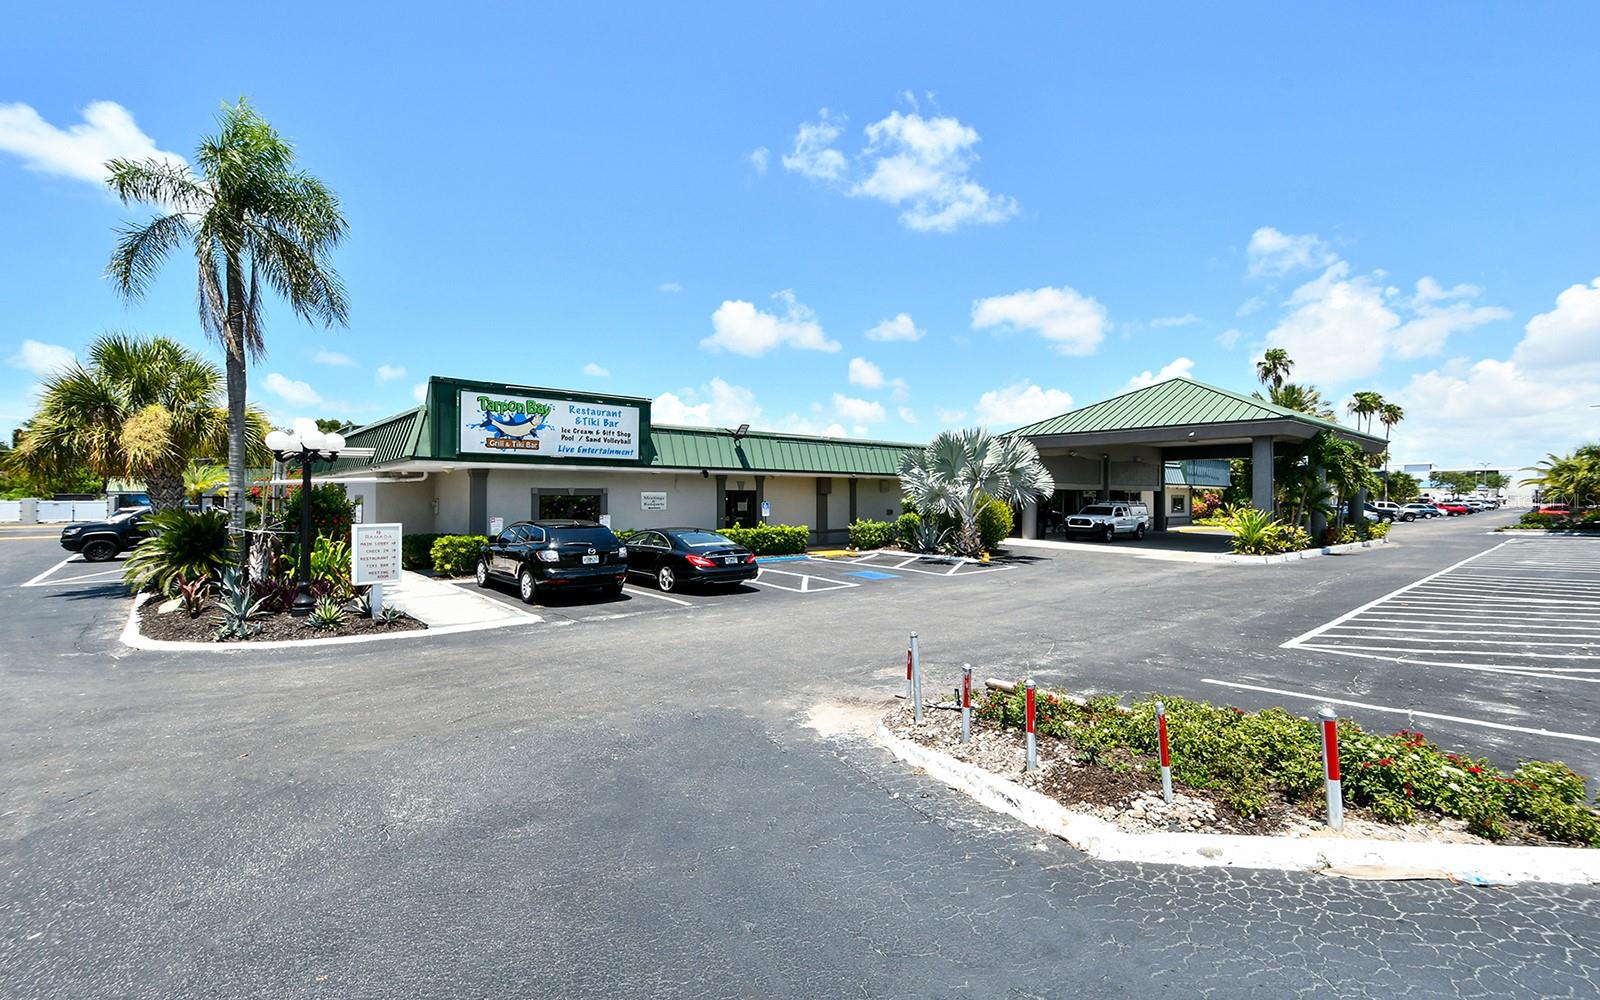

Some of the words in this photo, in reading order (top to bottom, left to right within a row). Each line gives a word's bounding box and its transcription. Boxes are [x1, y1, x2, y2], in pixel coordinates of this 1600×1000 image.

[477, 396, 525, 415] Tarpon
[526, 400, 551, 417] Bay
[569, 405, 622, 418] Restaurant
[603, 419, 619, 427] Bar
[603, 437, 631, 445] Volleyball
[558, 445, 574, 453] Live
[577, 446, 634, 456] Entertainment
